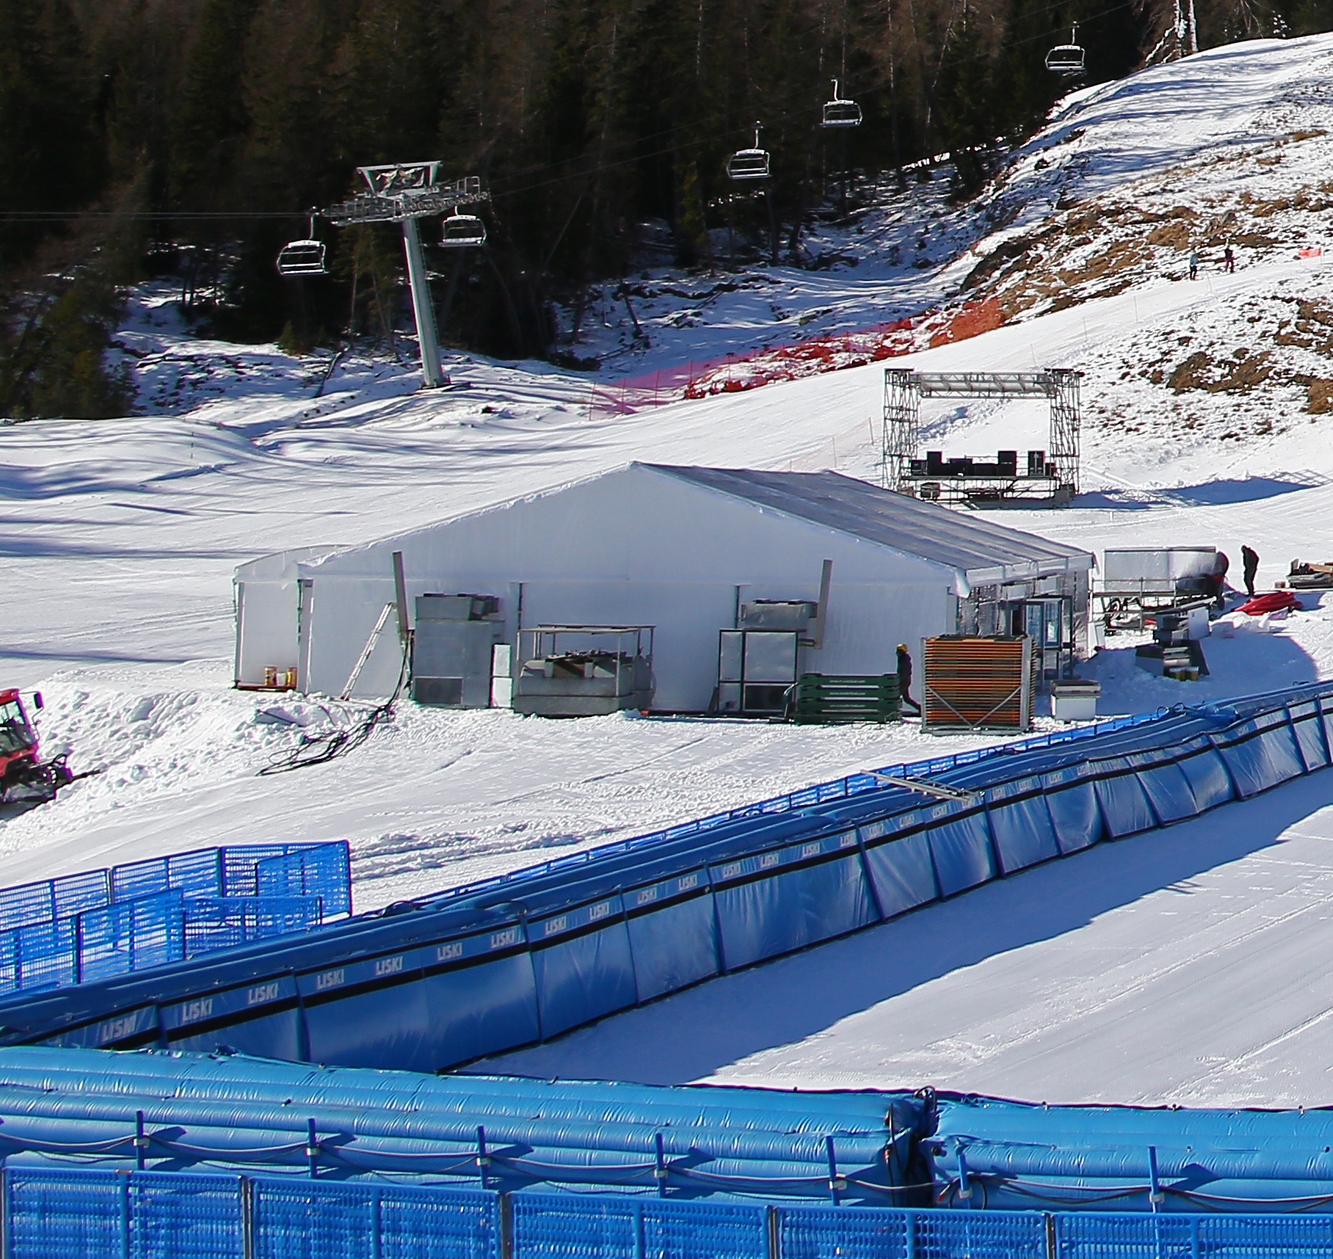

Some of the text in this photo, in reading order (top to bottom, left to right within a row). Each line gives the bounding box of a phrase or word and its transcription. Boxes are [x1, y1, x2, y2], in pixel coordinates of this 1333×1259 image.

[678, 874, 697, 891] LISKI
[590, 902, 609, 920] LISKI
[545, 916, 566, 935] LISKI
[491, 928, 515, 948] LISKI
[437, 943, 462, 961] LISKI
[376, 956, 403, 975] LISKI
[317, 969, 344, 989] LISKI
[248, 983, 278, 1004] LISKI
[183, 998, 212, 1021] LISKI
